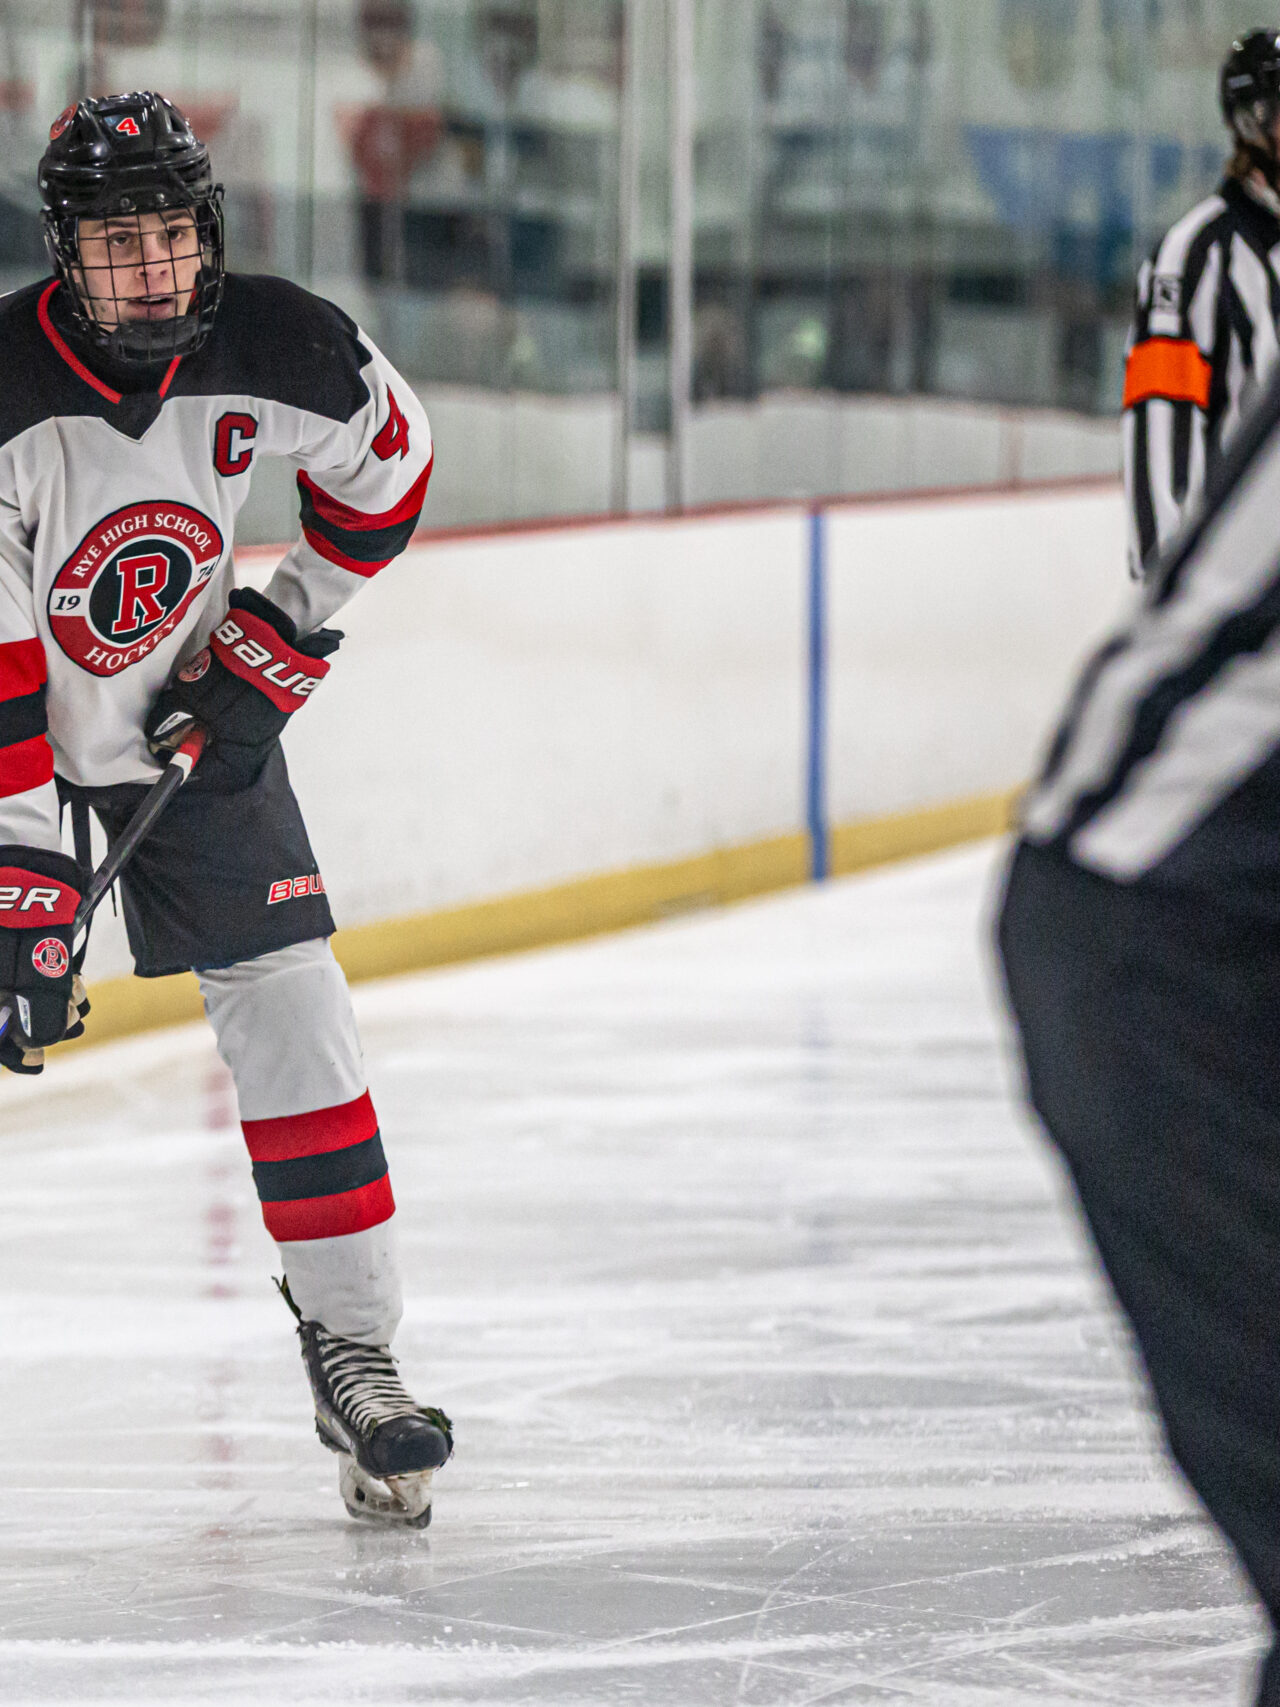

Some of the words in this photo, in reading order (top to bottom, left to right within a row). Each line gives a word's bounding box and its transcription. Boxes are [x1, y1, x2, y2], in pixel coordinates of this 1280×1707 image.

[116, 117, 140, 136] 4
[213, 411, 259, 477] C
[370, 382, 410, 461] 4
[72, 545, 102, 578] RYE
[100, 514, 148, 547] HIGH
[154, 513, 212, 552] SCHOOL
[54, 595, 81, 610] 19
[111, 552, 170, 634] R
[84, 617, 176, 670] HOCKEY
